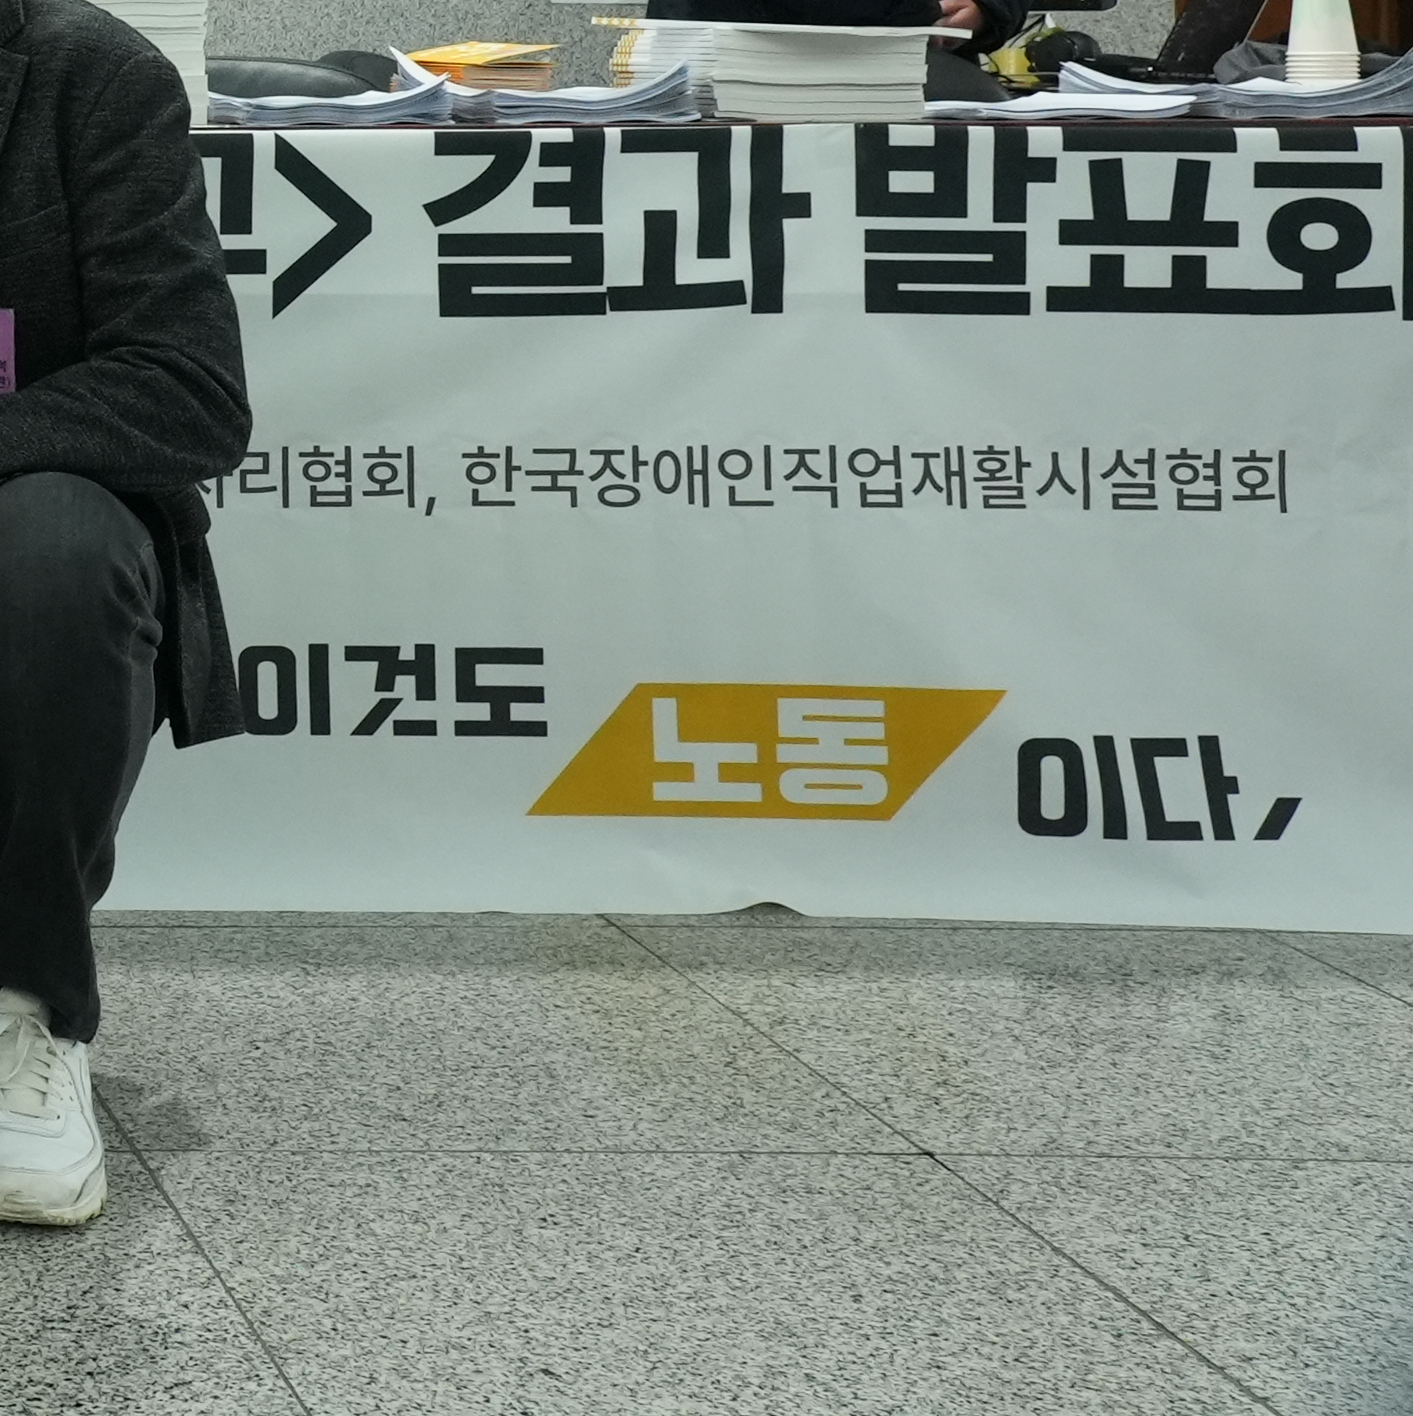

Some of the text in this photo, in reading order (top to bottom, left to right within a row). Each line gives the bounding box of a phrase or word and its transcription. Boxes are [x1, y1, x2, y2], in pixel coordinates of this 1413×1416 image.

[424, 125, 811, 317] 결과
[856, 125, 1413, 321] 발표회
[462, 443, 1290, 515] 한국장애인직업재활시설협회
[241, 644, 548, 738] 이것도
[652, 696, 888, 805] 노동
